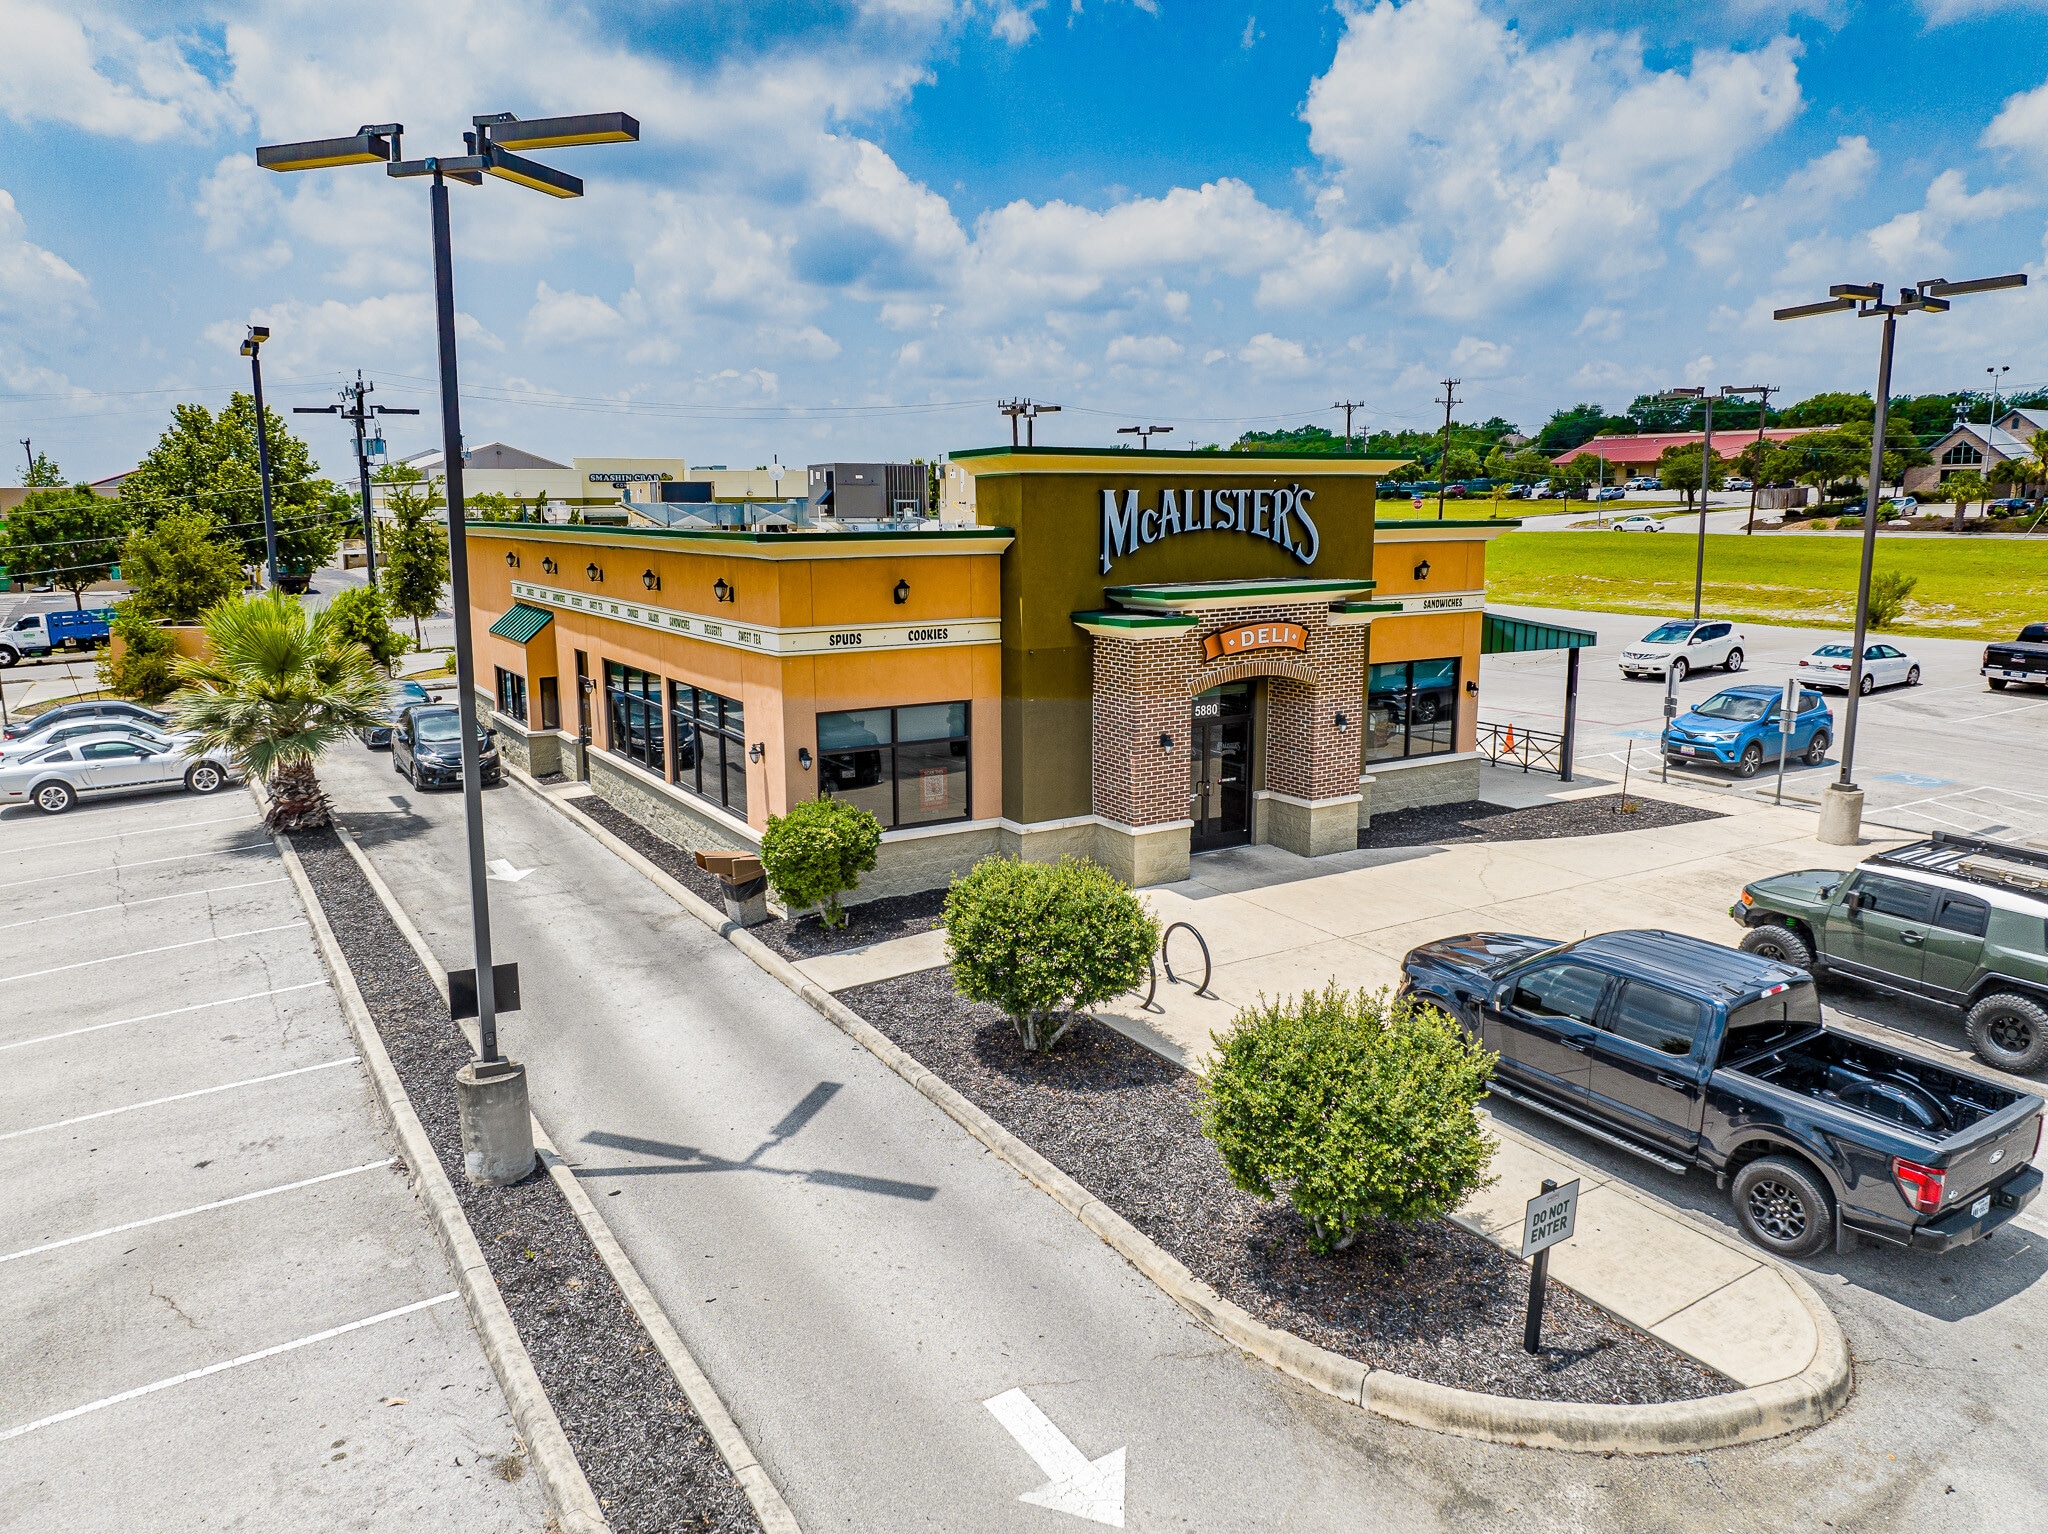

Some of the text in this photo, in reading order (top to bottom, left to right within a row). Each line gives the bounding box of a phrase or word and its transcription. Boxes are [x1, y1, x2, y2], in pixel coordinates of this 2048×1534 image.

[589, 474, 660, 482] SMASHIN CRAB
[1423, 598, 1463, 609] SANDWICHES
[669, 616, 690, 631] SANDWICHES
[704, 623, 723, 637] DESSERTS
[738, 630, 752, 644] SWEET
[753, 634, 762, 645] TEA
[829, 628, 948, 646] SPUDS COOKIES
[1241, 627, 1289, 647] DELI
[1194, 704, 1218, 717] 5880
[1533, 1199, 1570, 1227] DO NOT
[1531, 1216, 1567, 1243] ENTER
